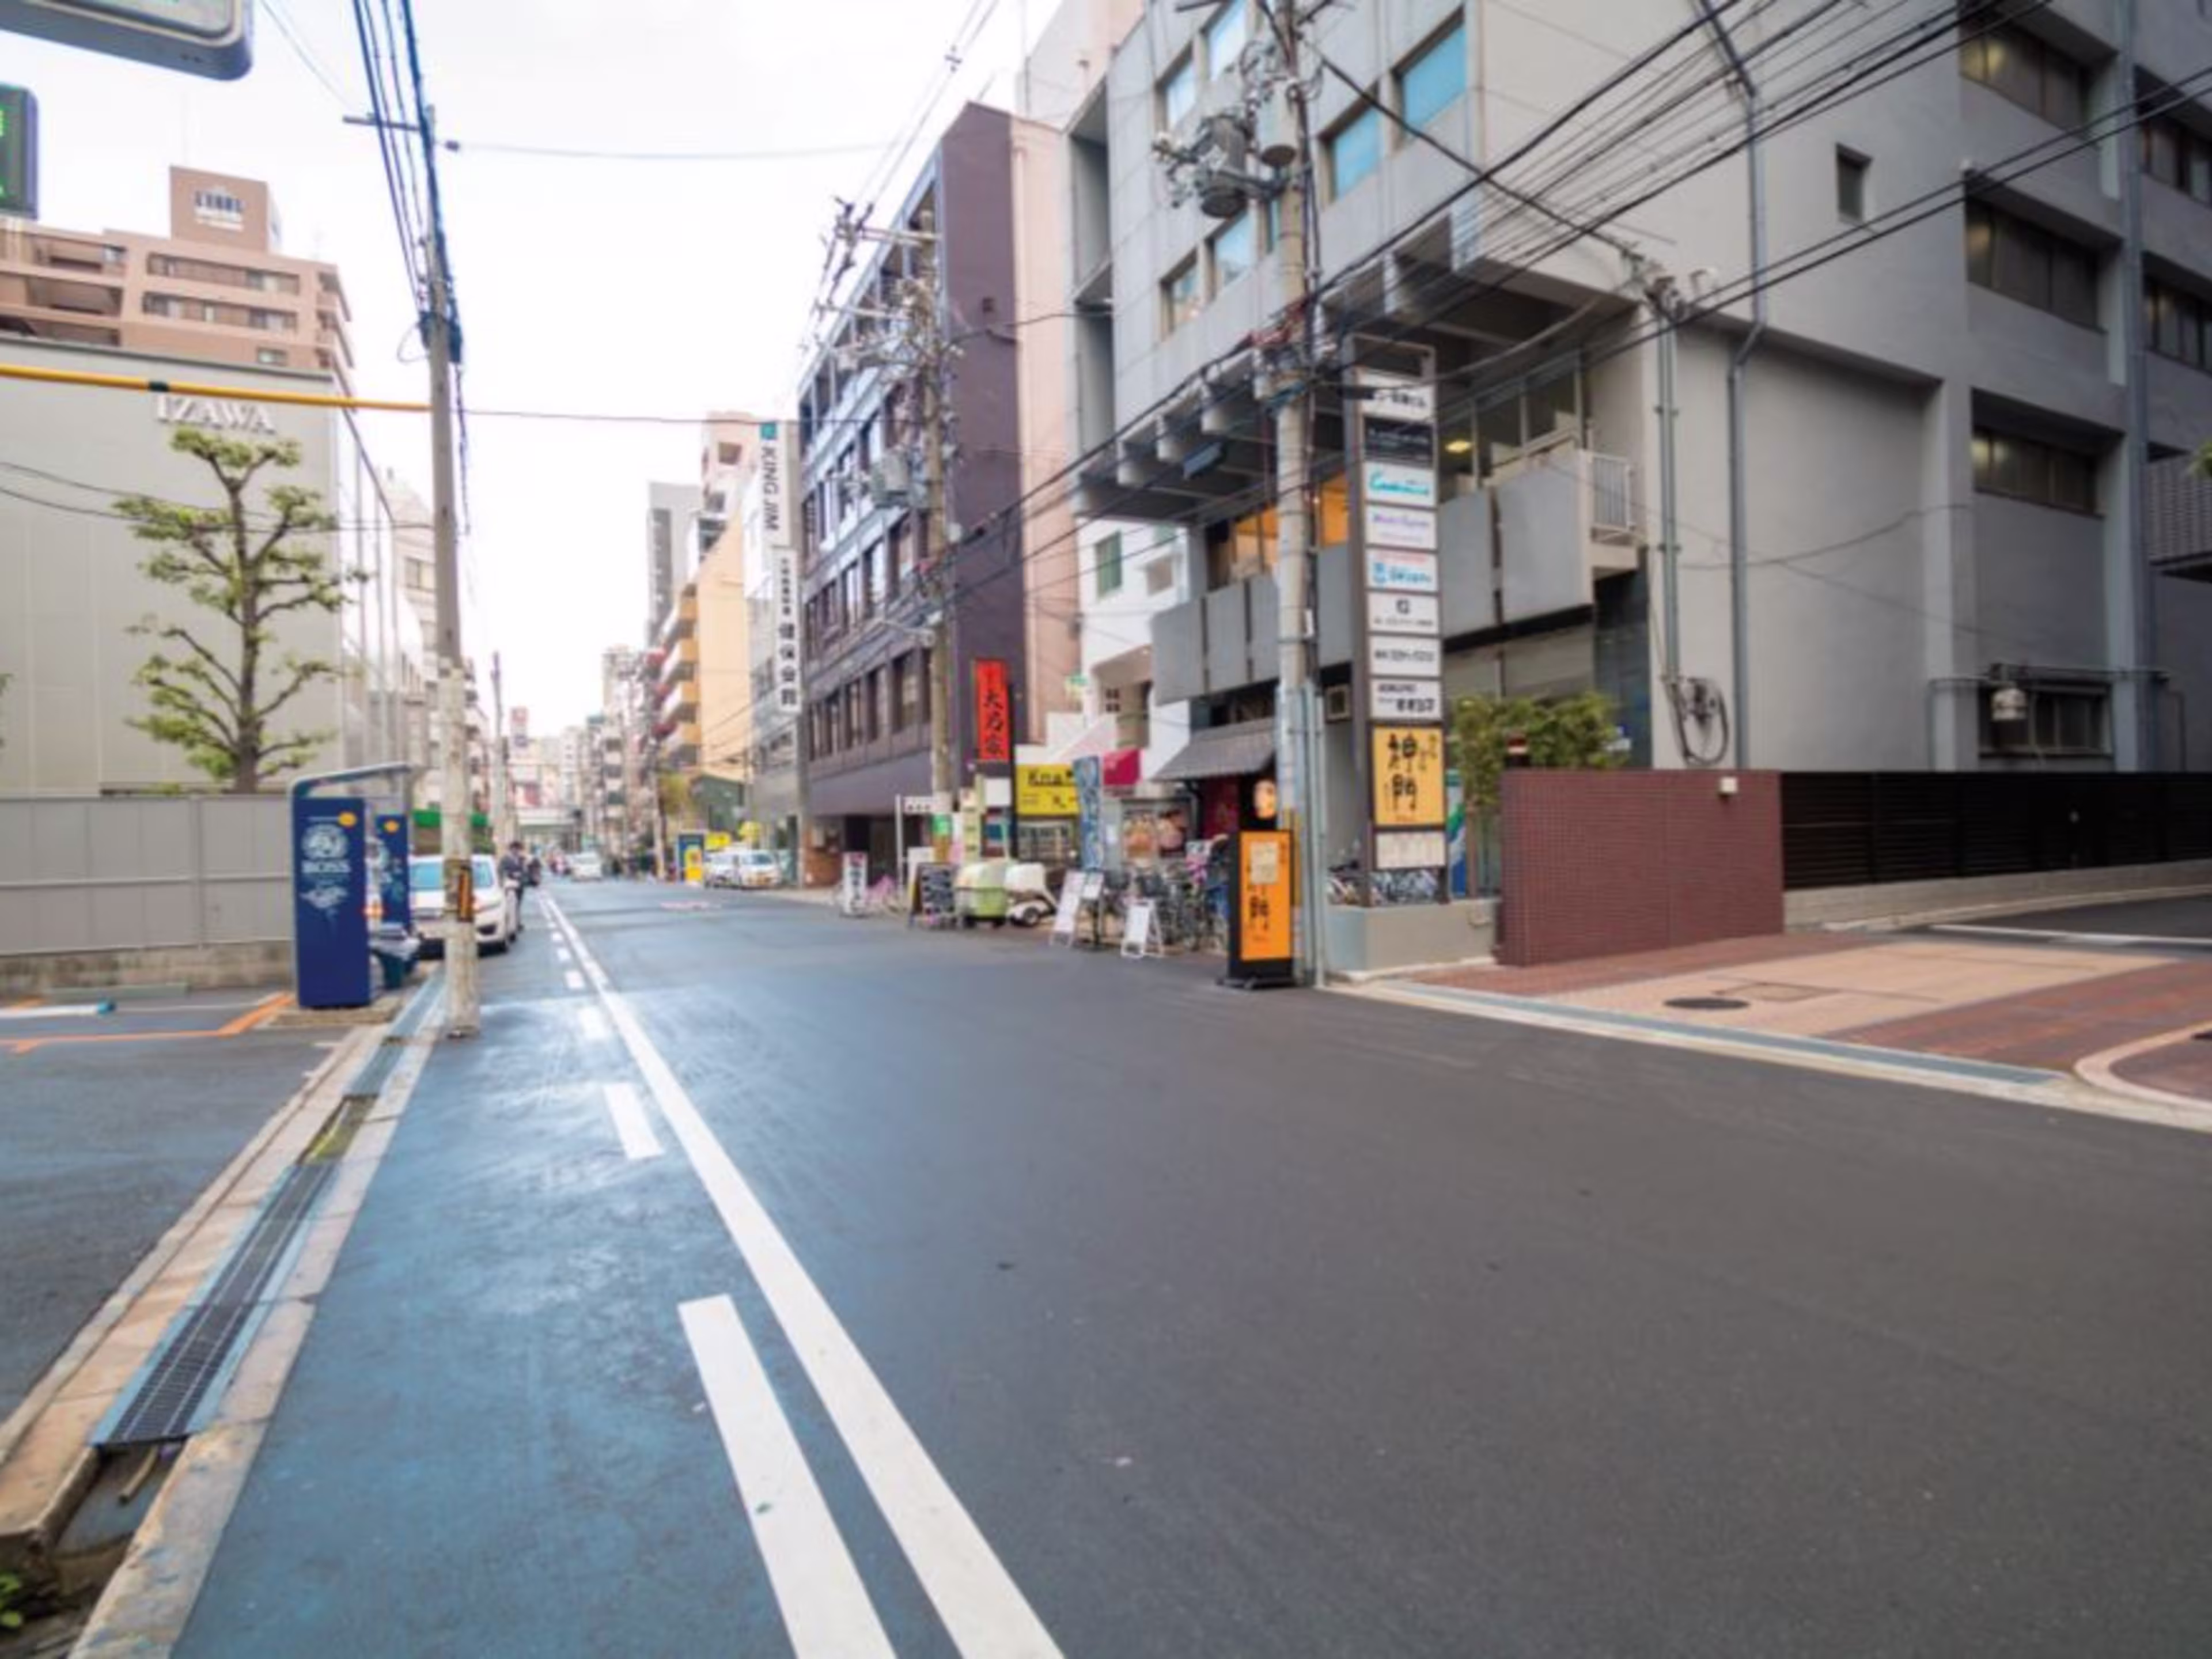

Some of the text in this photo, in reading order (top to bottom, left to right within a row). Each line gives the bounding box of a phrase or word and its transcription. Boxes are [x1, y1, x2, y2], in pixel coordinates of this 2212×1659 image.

[154, 395, 276, 434] IZAWA
[761, 445, 779, 531] KING JIM
